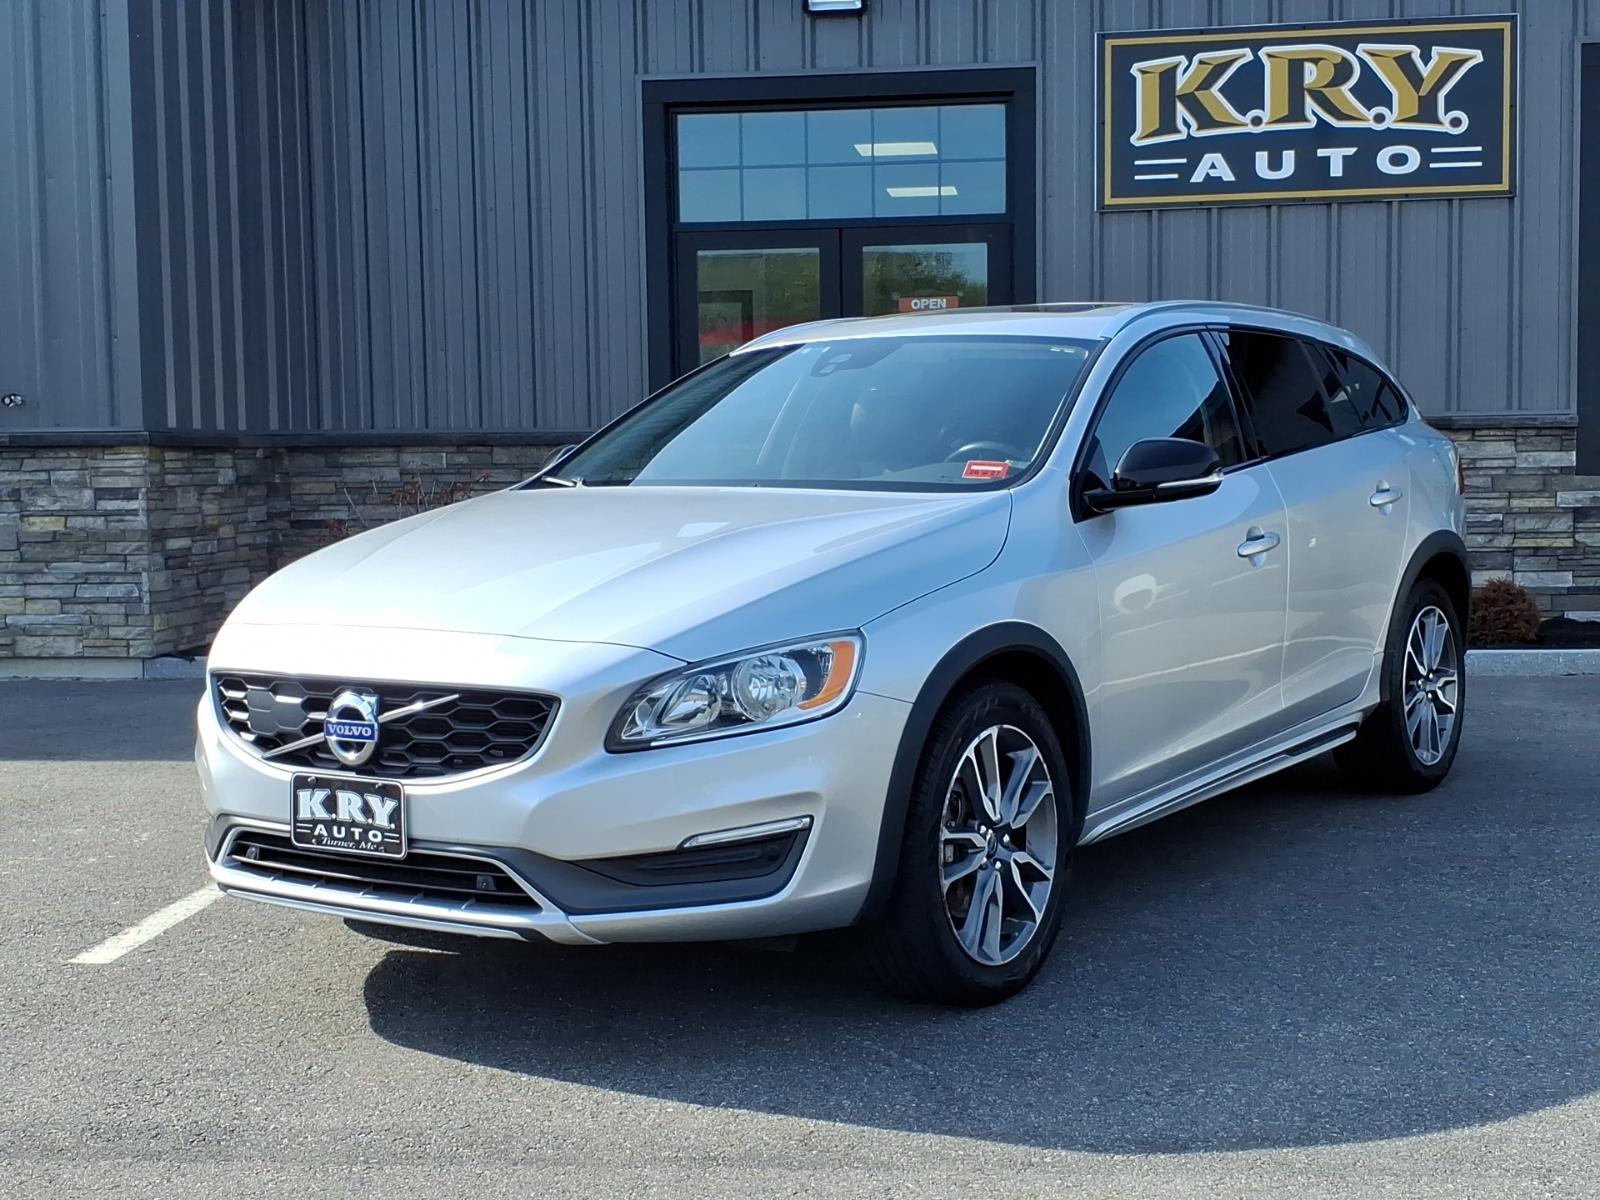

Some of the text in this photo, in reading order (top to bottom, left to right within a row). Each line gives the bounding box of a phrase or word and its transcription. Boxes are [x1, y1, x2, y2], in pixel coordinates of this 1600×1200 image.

[1190, 145, 1421, 183] AUTO
[911, 298, 947, 310] OPEN
[327, 723, 372, 737] VOLVO
[313, 823, 383, 842] AUTO
